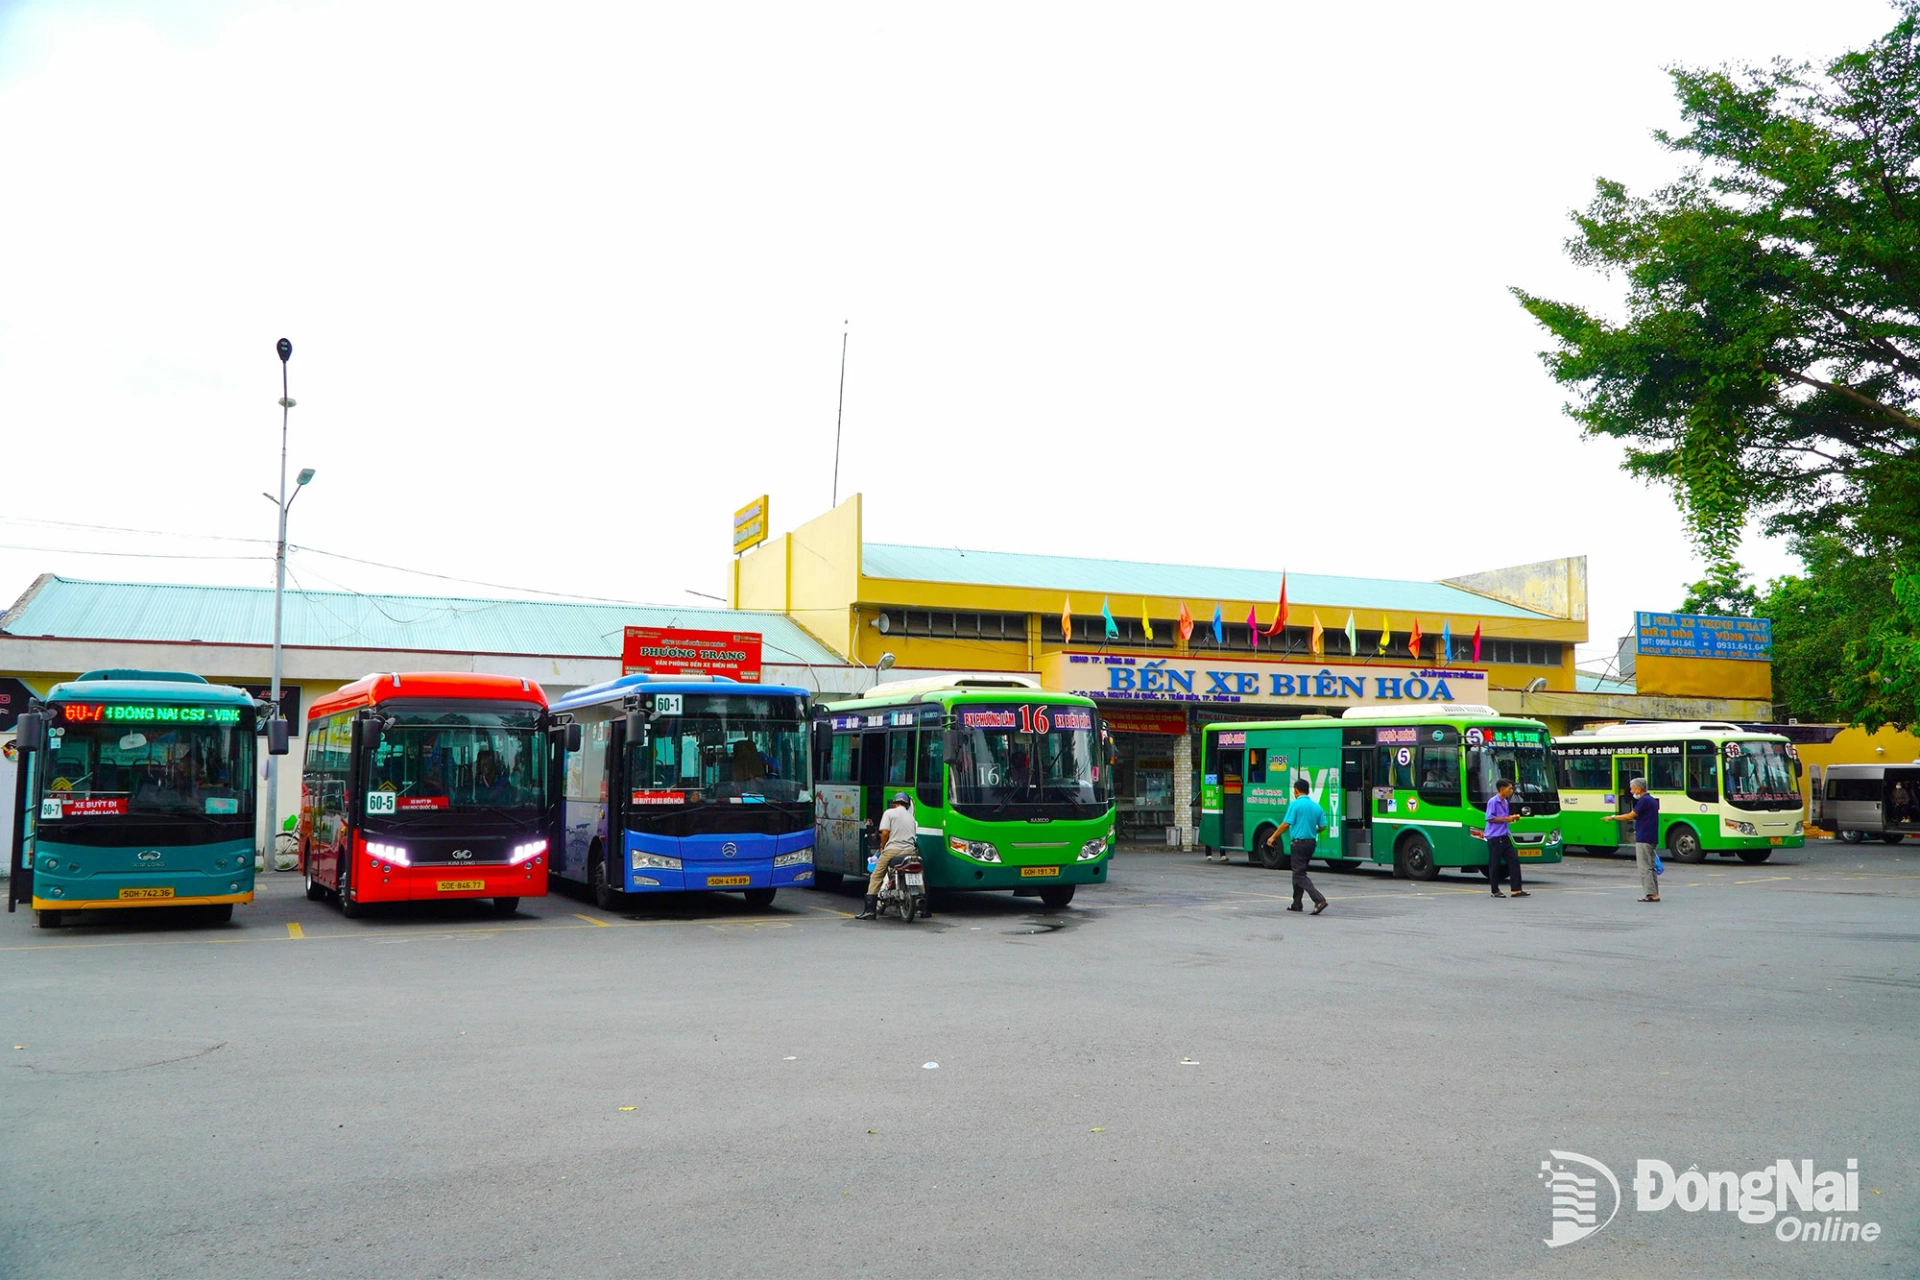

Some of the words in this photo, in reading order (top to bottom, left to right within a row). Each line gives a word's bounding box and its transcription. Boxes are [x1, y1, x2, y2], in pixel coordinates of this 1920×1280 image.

[640, 646, 696, 658] PHƯƠNG
[699, 650, 746, 661] TRANG
[1716, 642, 1768, 651] 0931.641.64
[1107, 657, 1196, 692] BẾN
[1206, 670, 1260, 695] XE
[1269, 669, 1366, 698] BIÊN
[1375, 671, 1455, 700] HÒA
[657, 697, 680, 711] 60-1
[1018, 704, 1050, 734] 16
[1055, 714, 1065, 728] BX
[1469, 731, 1480, 744] 5
[1400, 750, 1408, 763] 5
[979, 766, 1000, 785] 16
[43, 804, 60, 815] 60-7
[86, 800, 107, 808] BUÝT
[370, 795, 393, 810] 60-5
